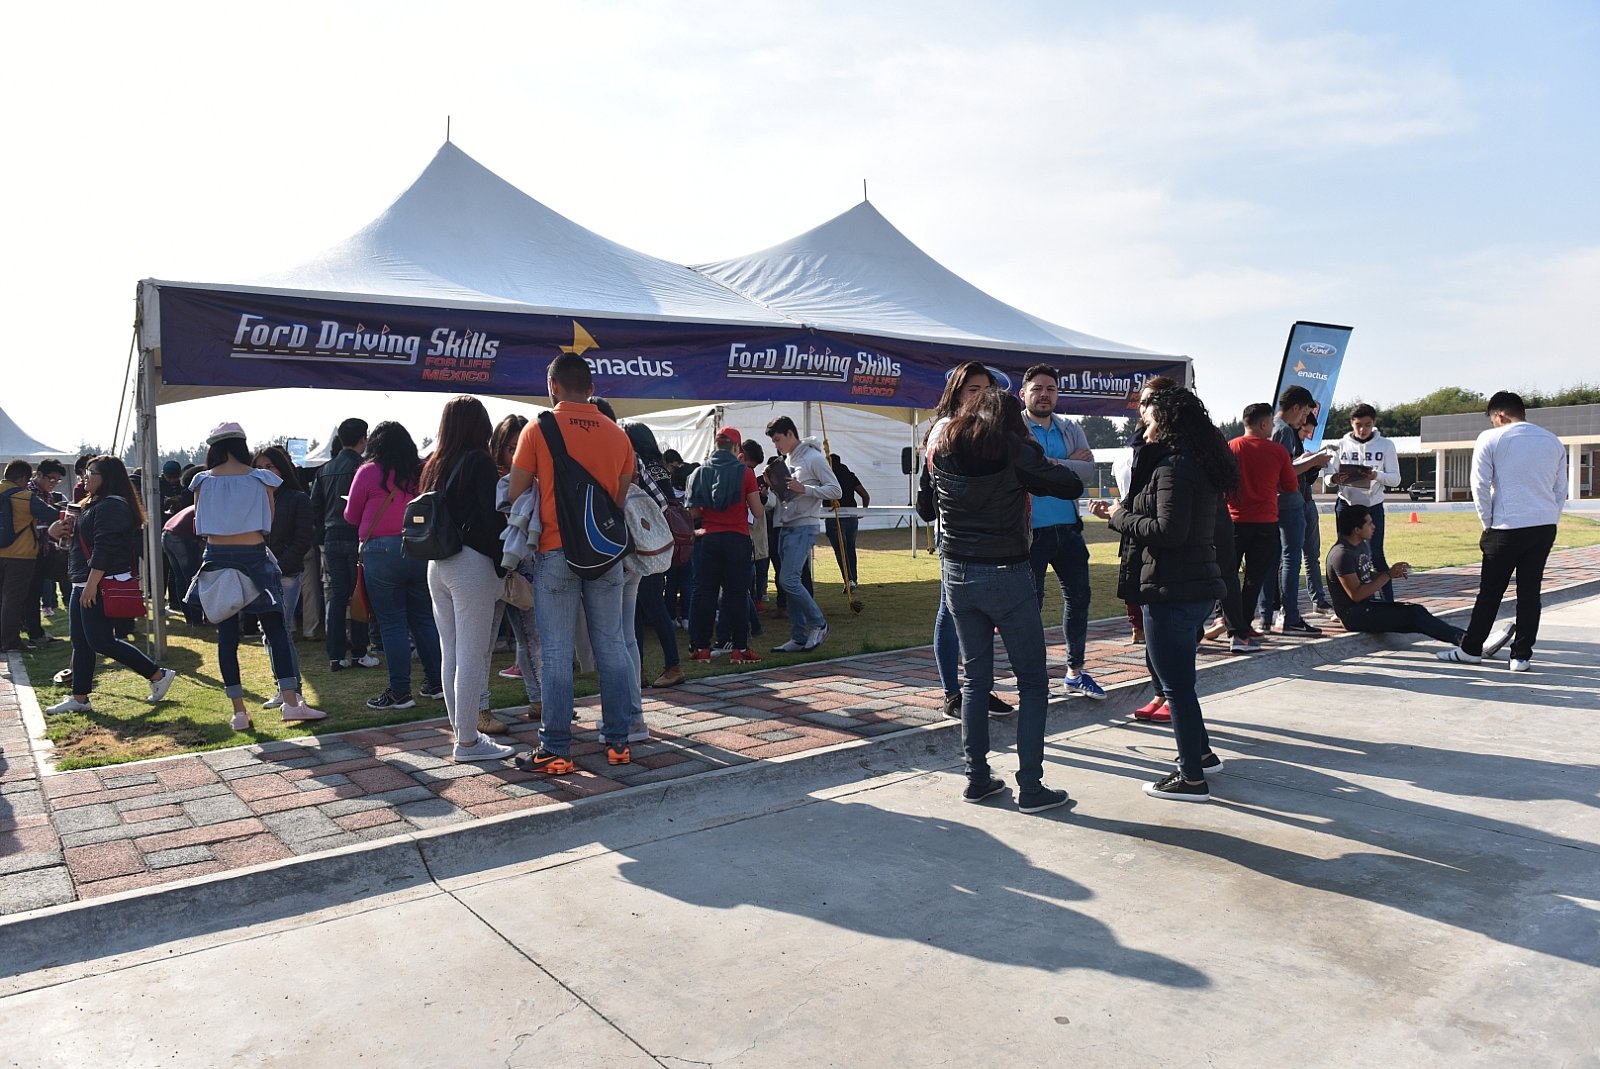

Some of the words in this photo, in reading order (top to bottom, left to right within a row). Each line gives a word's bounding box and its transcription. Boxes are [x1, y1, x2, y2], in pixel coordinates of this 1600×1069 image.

[315, 320, 421, 365] Driving
[426, 327, 500, 359] Skills
[425, 357, 457, 368] FOR
[460, 358, 491, 369] LIFE
[583, 355, 674, 377] enactus
[781, 344, 852, 383] Driving
[854, 351, 902, 377] Skills
[421, 367, 490, 382] MÉXICO
[852, 375, 874, 384] FOR
[876, 376, 897, 386] LIFE
[1297, 370, 1329, 381] enactus
[1082, 370, 1131, 399] Driving
[1340, 451, 1384, 461] AERO
